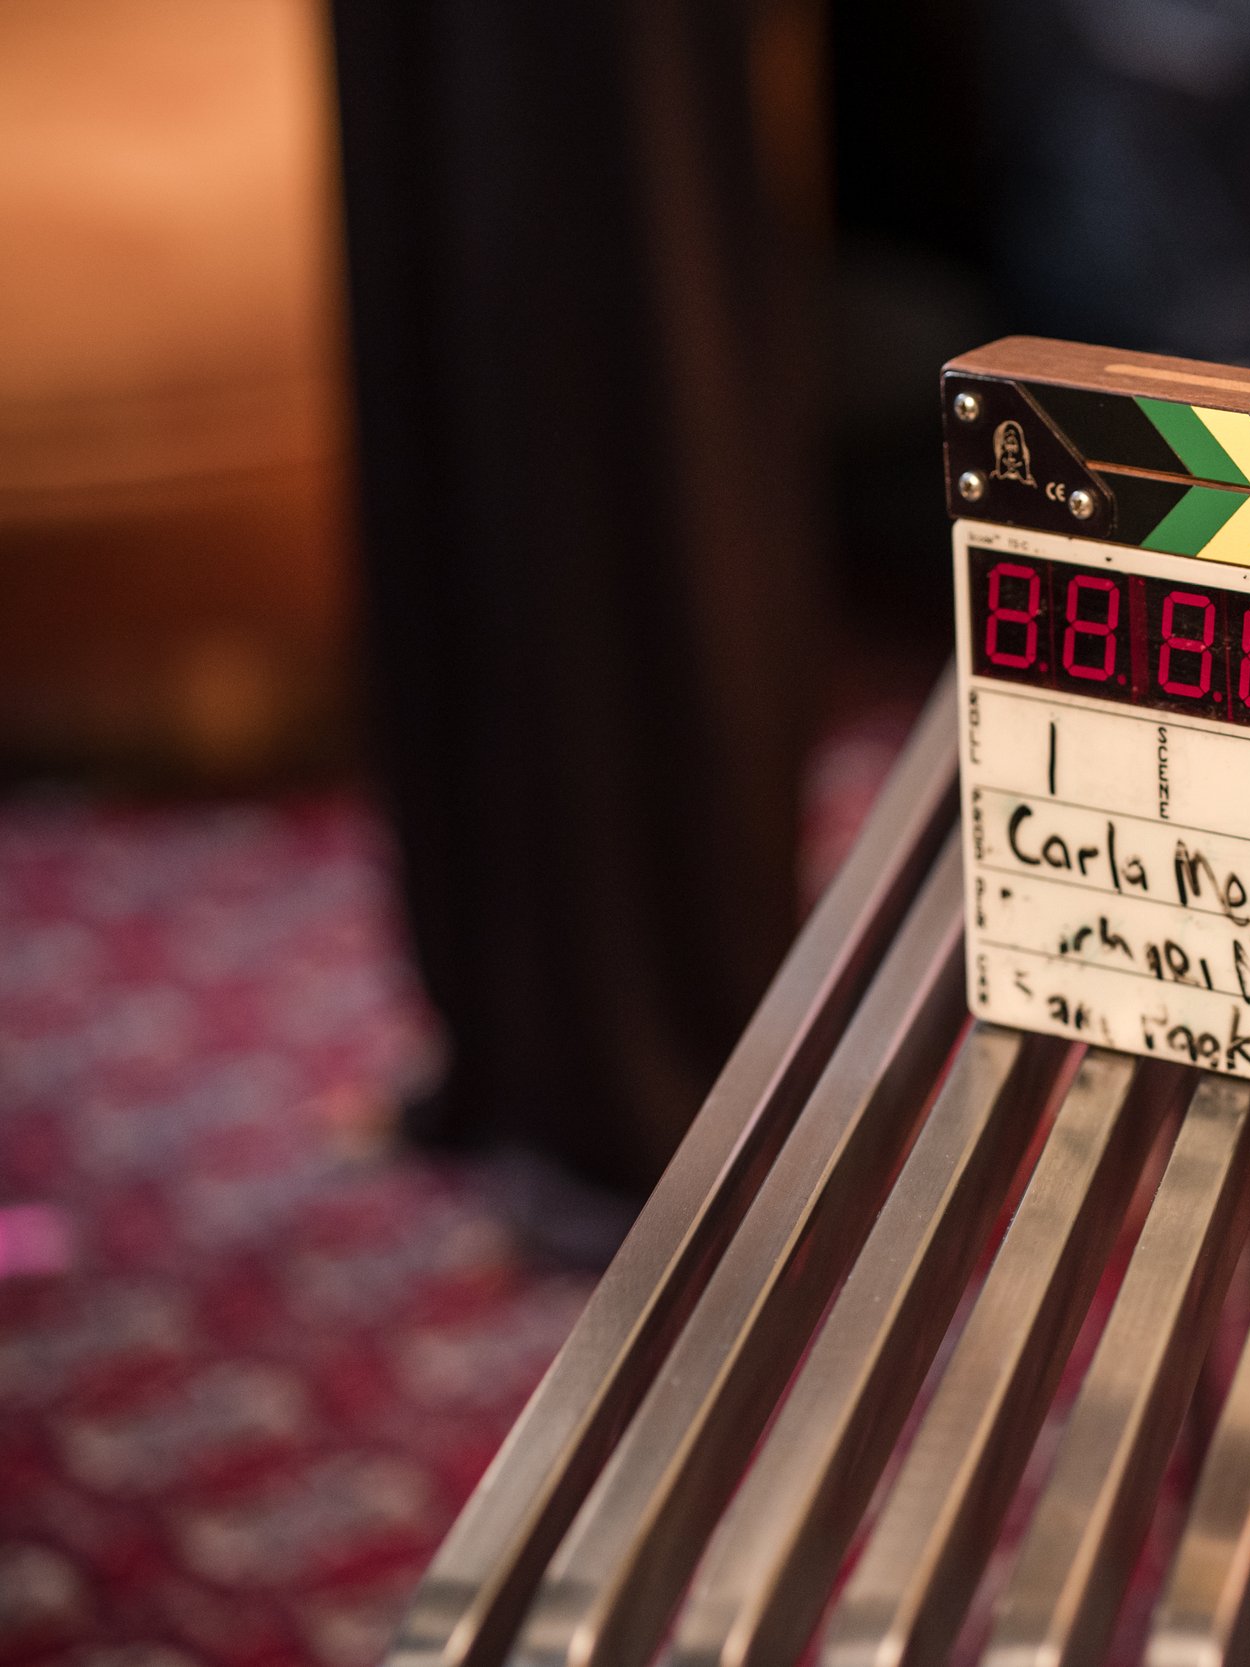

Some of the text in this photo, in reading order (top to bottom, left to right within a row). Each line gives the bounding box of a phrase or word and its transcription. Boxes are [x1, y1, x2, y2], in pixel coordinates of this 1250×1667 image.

[1045, 481, 1066, 502] CE
[1157, 726, 1170, 820] SCENE
[1008, 804, 1149, 894] Carla
